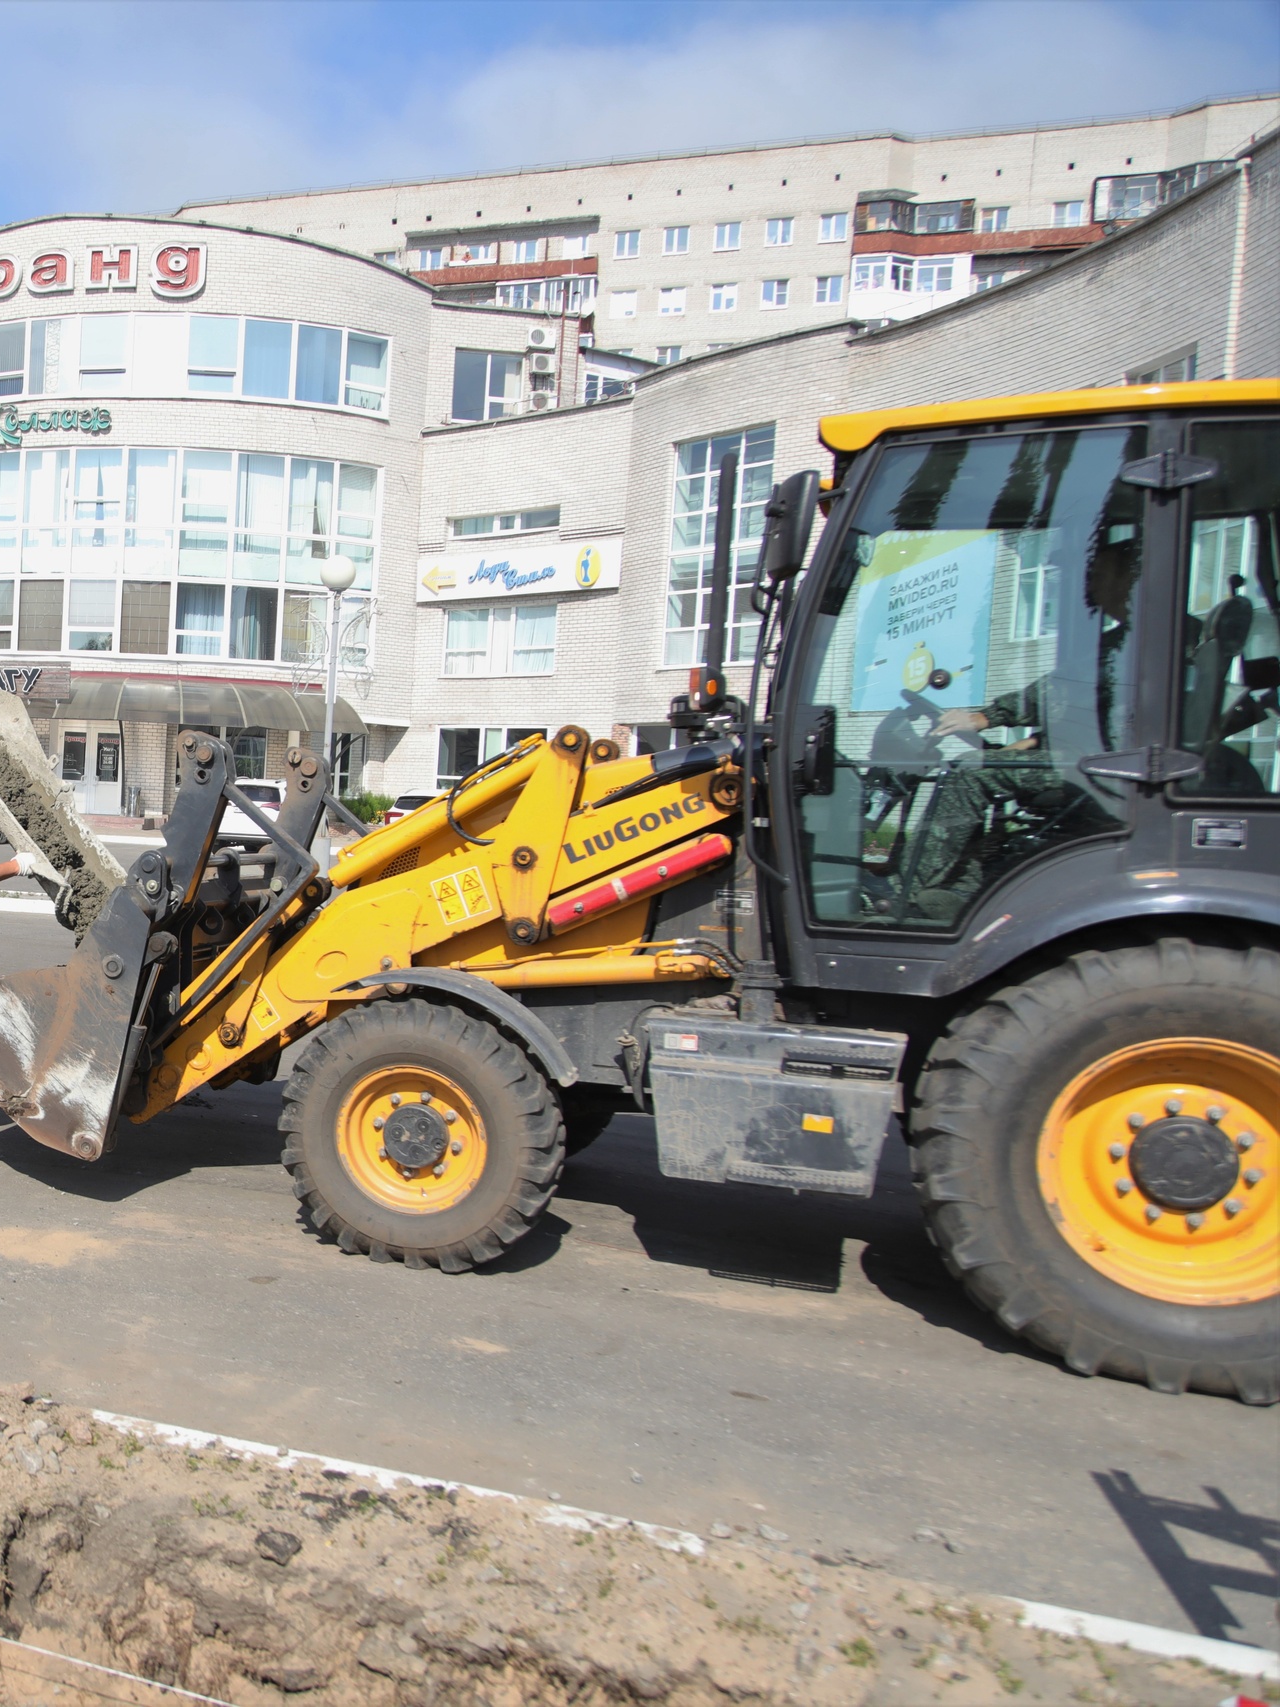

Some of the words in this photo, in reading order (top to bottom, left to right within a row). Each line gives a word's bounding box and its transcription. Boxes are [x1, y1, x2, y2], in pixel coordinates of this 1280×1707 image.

[503, 565, 556, 589] Стиль
[887, 575, 959, 612] MVIDEO.RU
[889, 571, 940, 597] ЗАКАЖИ
[942, 562, 959, 577] НА
[886, 626, 899, 641] 15
[902, 606, 957, 636] МИНУТ
[887, 606, 924, 626] ЗАБЕРИ
[926, 593, 957, 611] ЧЕРЕЗ
[907, 655, 927, 678] 15
